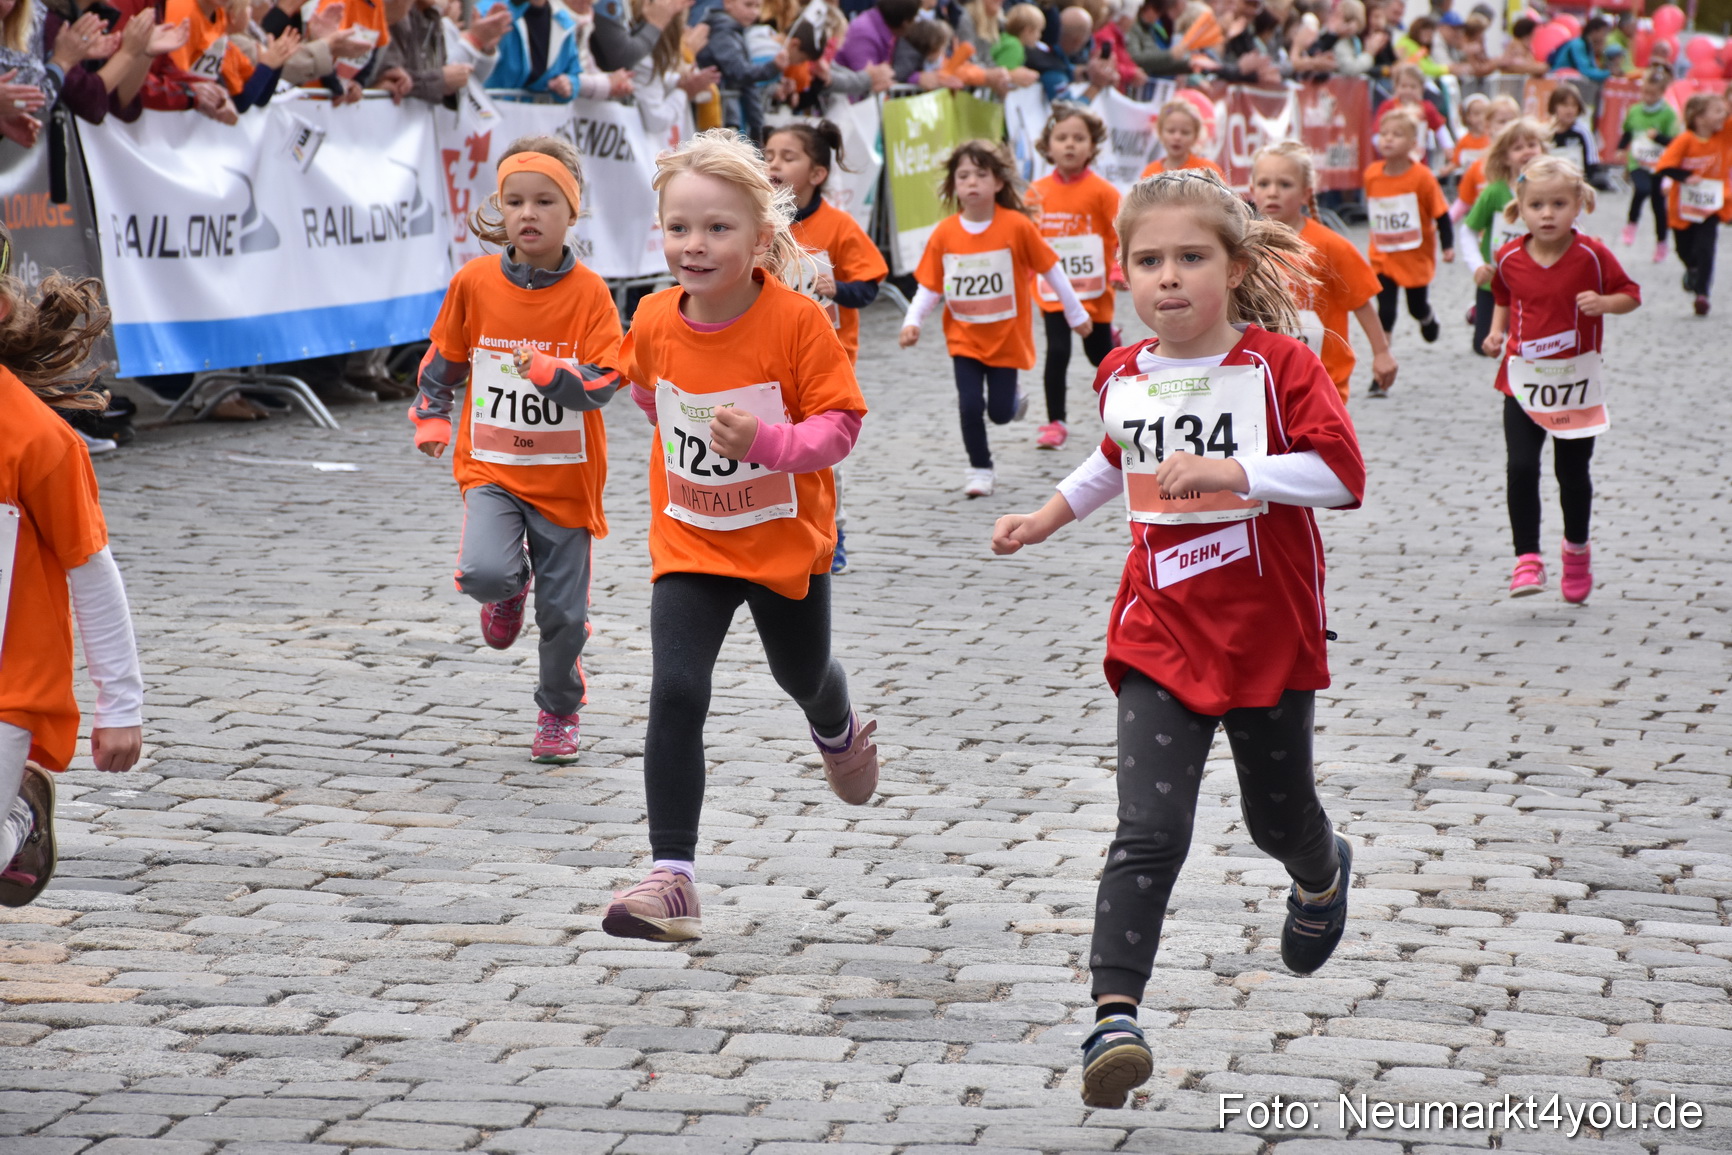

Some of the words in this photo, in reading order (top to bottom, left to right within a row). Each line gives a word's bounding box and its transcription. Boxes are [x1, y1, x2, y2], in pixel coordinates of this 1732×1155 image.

[302, 202, 408, 248] RAIL.ONE
[1375, 212, 1411, 230] 7162
[111, 214, 237, 259] RAIL.ONE
[951, 272, 1003, 296] 7220
[478, 334, 552, 351] Neumarkter
[1535, 340, 1561, 353] DEHN
[1160, 377, 1210, 395] BOCK
[1523, 378, 1589, 407] 7077
[488, 386, 563, 425] 7160
[1550, 415, 1570, 425] Leni
[513, 435, 534, 448] Zoe
[1123, 413, 1238, 463] 7134
[1126, 456, 1134, 466] B1
[681, 484, 755, 512] NATALIE
[1179, 541, 1221, 570] DEHN
